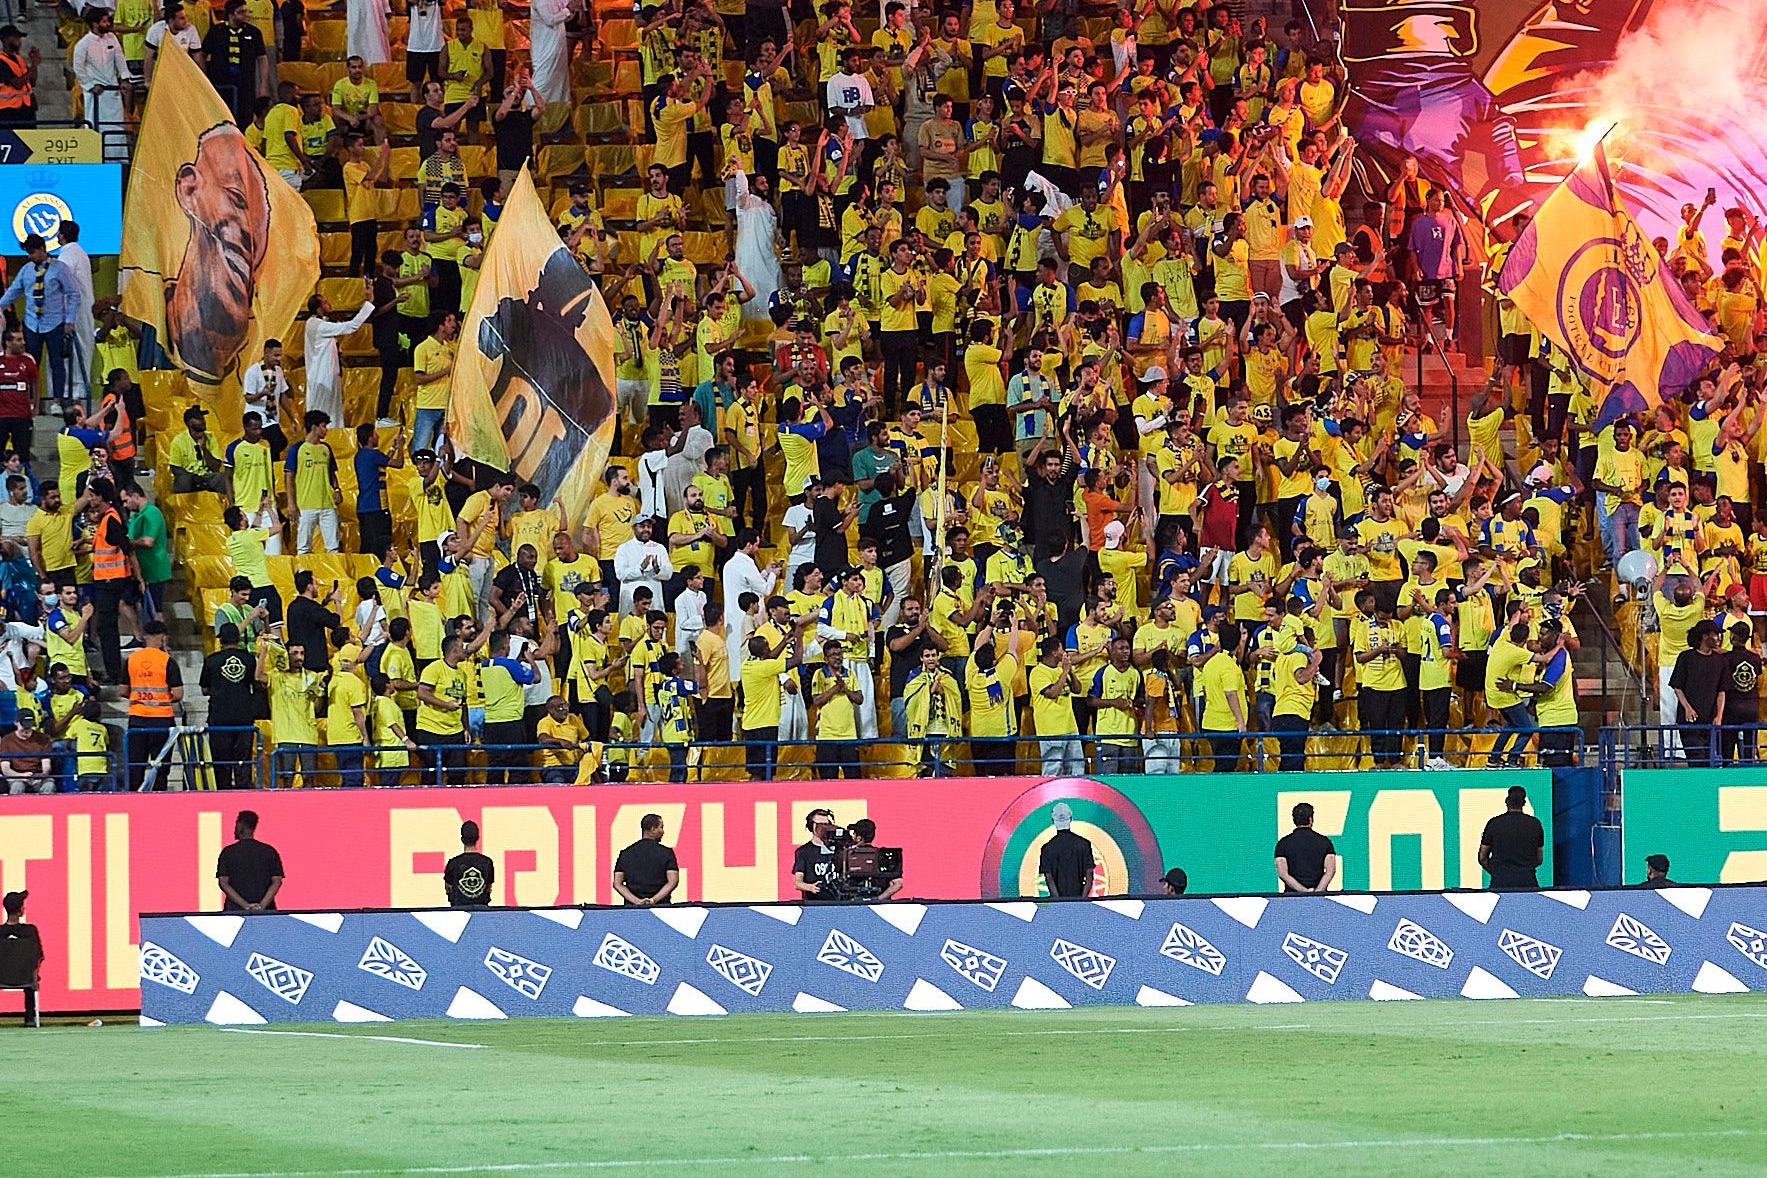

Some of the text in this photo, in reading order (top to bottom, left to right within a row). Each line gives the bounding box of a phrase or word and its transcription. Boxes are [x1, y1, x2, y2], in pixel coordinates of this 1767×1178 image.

[44, 136, 79, 153] خروج
[1368, 631, 1379, 651] 195
[90, 733, 101, 747] 7
